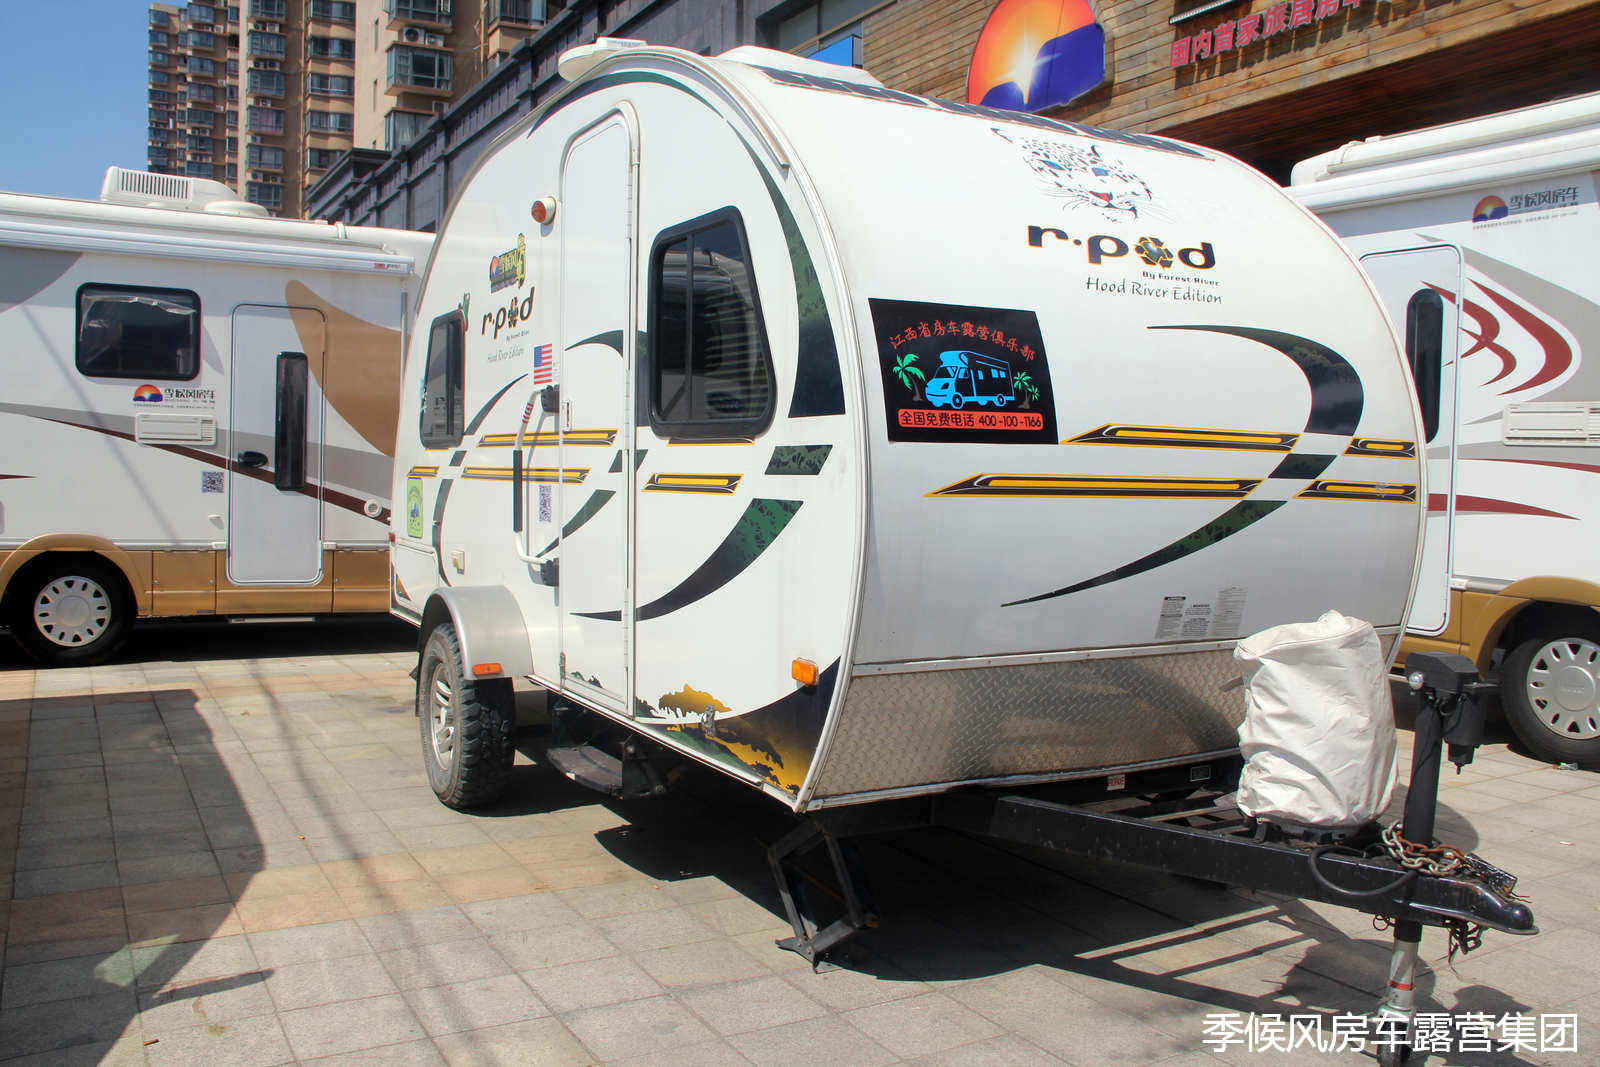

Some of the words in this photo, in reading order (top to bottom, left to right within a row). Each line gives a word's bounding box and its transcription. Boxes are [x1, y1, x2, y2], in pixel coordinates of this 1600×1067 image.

[1085, 276, 1127, 294] Hood
[1131, 279, 1169, 299] River
[1173, 286, 1223, 304] Edition
[888, 320, 1036, 361] 江西省房车露营俱乐部
[900, 410, 975, 427] 全国免费电话
